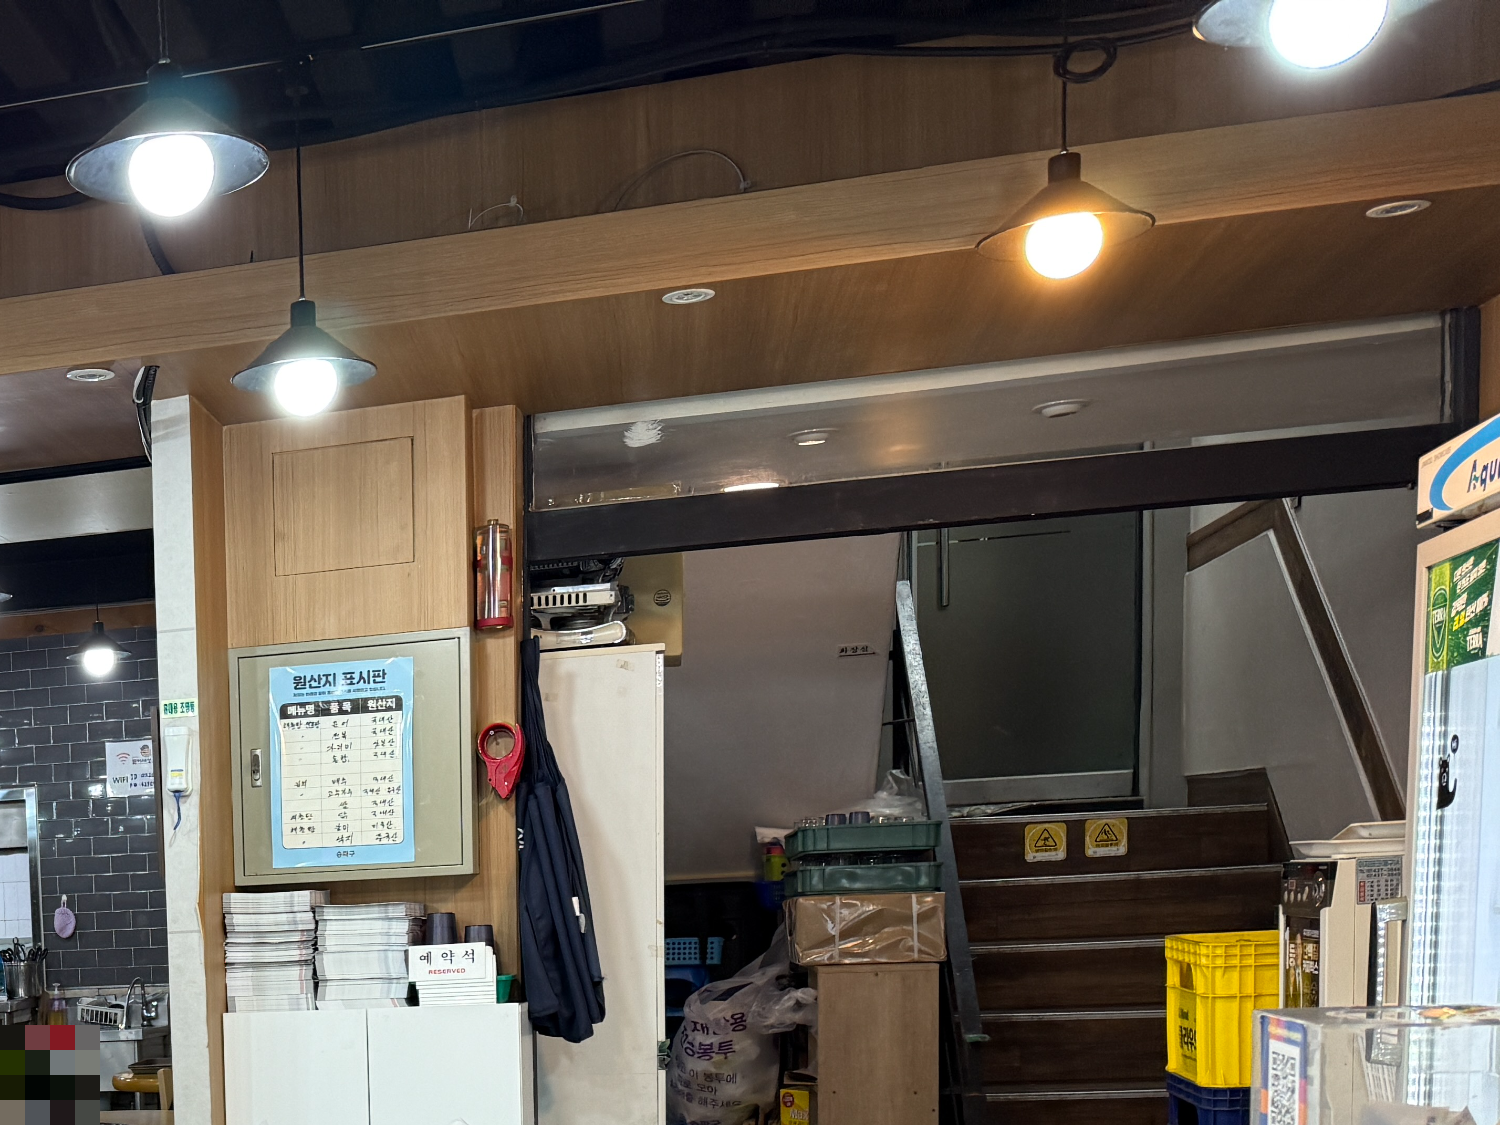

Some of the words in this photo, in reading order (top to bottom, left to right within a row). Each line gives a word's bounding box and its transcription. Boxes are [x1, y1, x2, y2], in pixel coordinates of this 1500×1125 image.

[292, 672, 336, 691] 원산지
[342, 669, 387, 687] 표시판
[287, 704, 315, 716] 메뉴명
[367, 698, 396, 710] 원산지
[419, 948, 475, 966] 예약석
[428, 967, 466, 975] RESERVED
[703, 1072, 737, 1084] 봉투에
